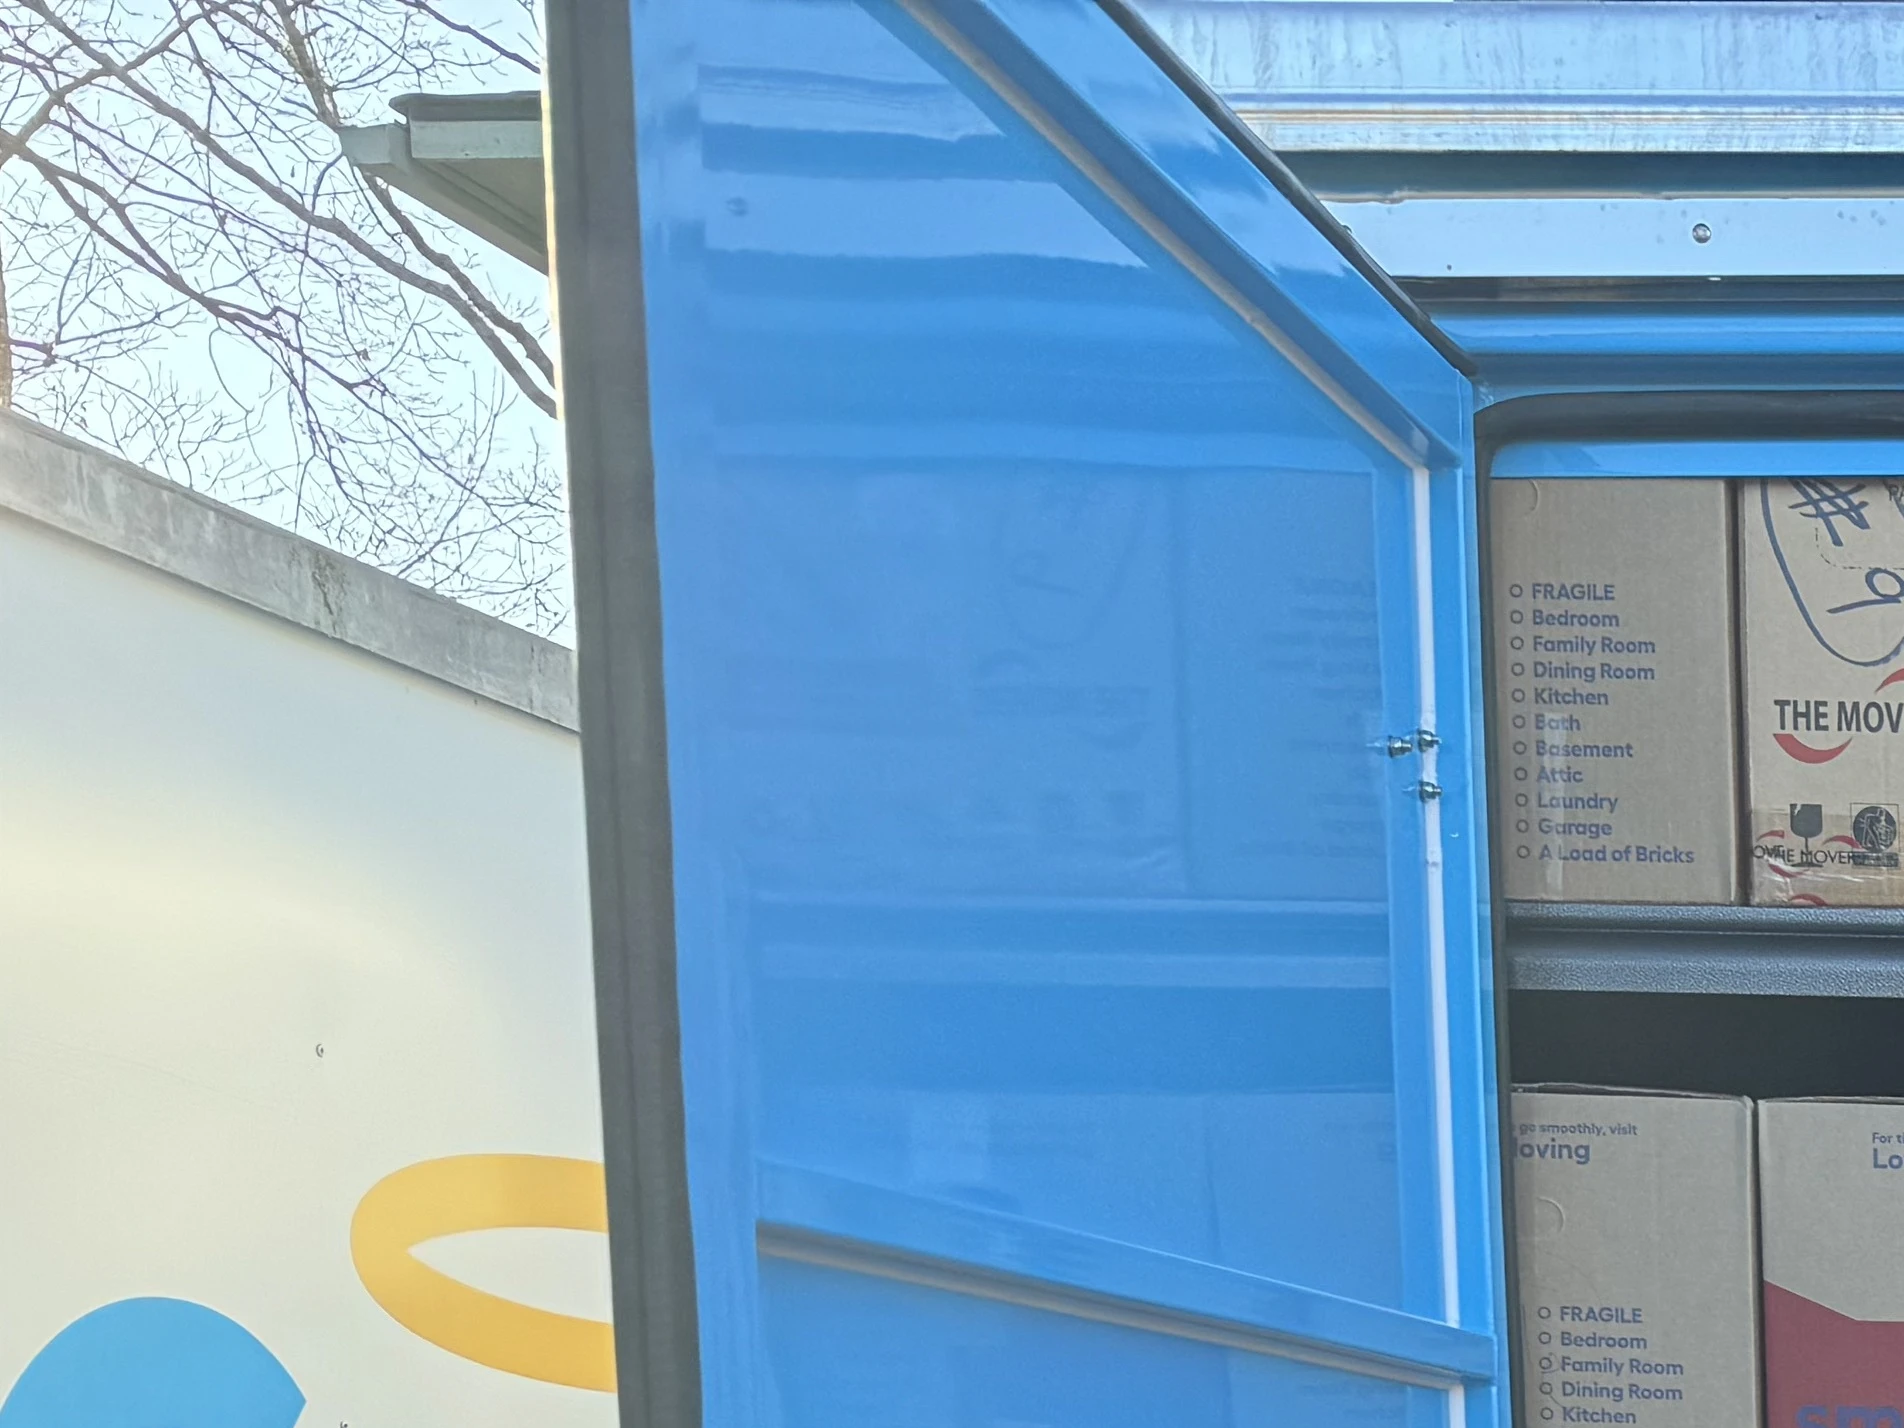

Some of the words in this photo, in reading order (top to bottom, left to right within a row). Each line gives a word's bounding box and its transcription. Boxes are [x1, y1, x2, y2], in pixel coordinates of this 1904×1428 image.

[1531, 583, 1615, 601] FRAGILE
[1532, 609, 1619, 627] Bedroom
[1532, 636, 1597, 655] Family
[1601, 637, 1657, 654] Room
[1532, 661, 1596, 683] Dining
[1600, 663, 1656, 681] Room
[1534, 688, 1610, 706] Kitchen
[1773, 698, 1829, 734] THE
[1536, 739, 1633, 759] Basement
